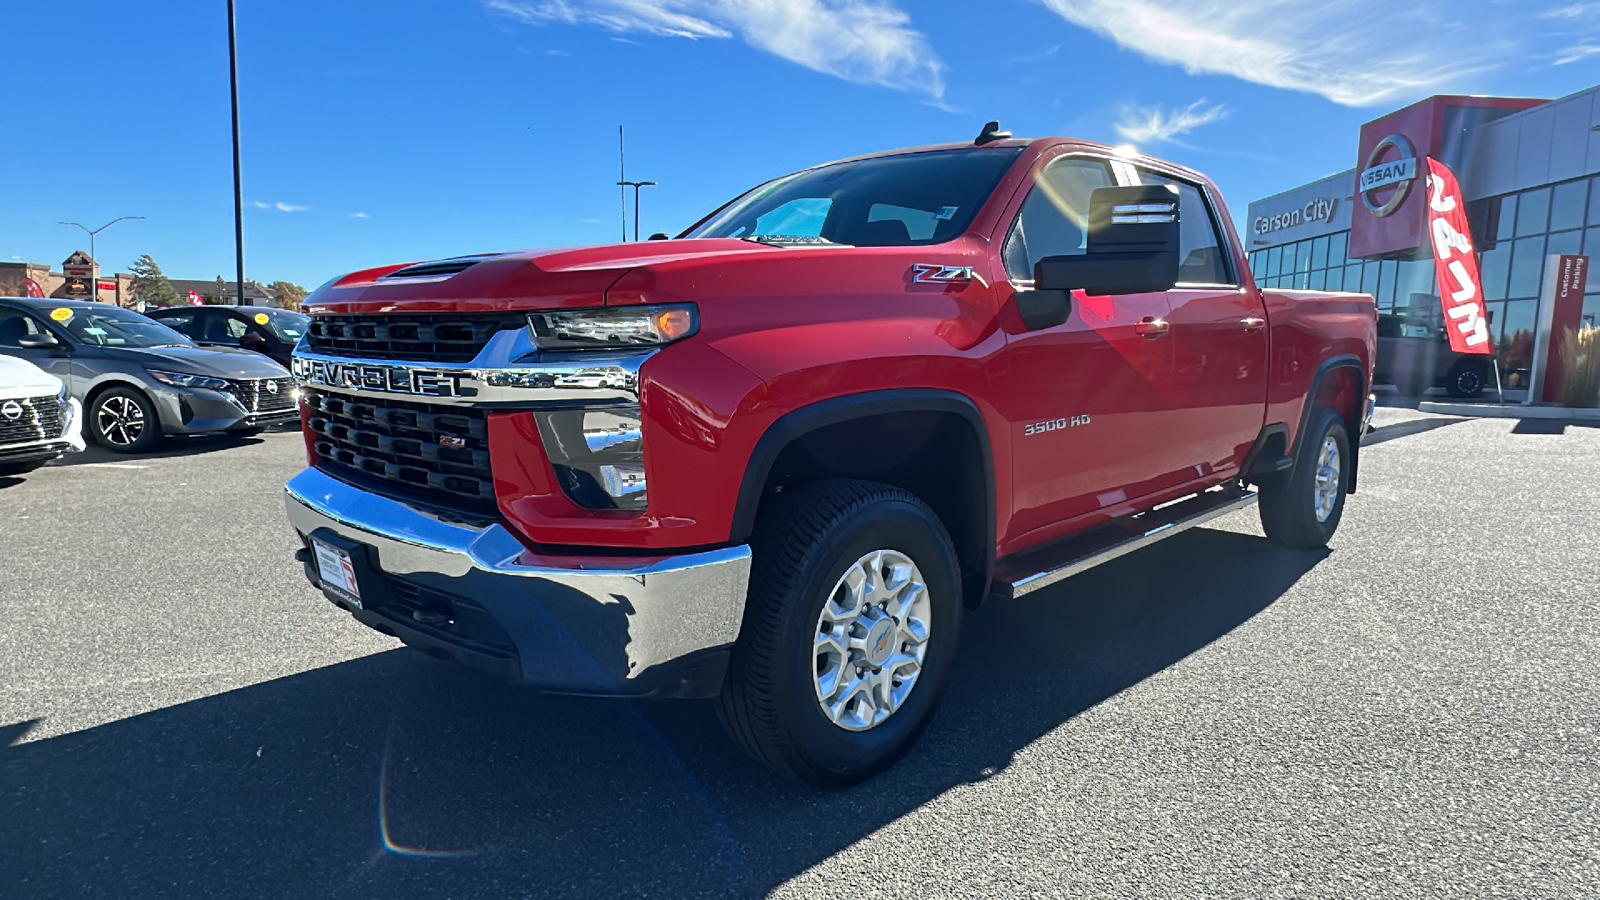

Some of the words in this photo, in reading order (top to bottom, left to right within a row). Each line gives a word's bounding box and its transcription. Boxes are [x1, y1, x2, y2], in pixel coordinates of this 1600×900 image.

[1253, 208, 1300, 235] Carson
[1303, 198, 1336, 224] City
[913, 263, 973, 284] Z71
[1561, 258, 1572, 298] Customer
[1572, 258, 1584, 290] Parking
[292, 357, 468, 398] CHEVROLET
[1024, 418, 1067, 436] 3500
[1070, 414, 1091, 427] HD
